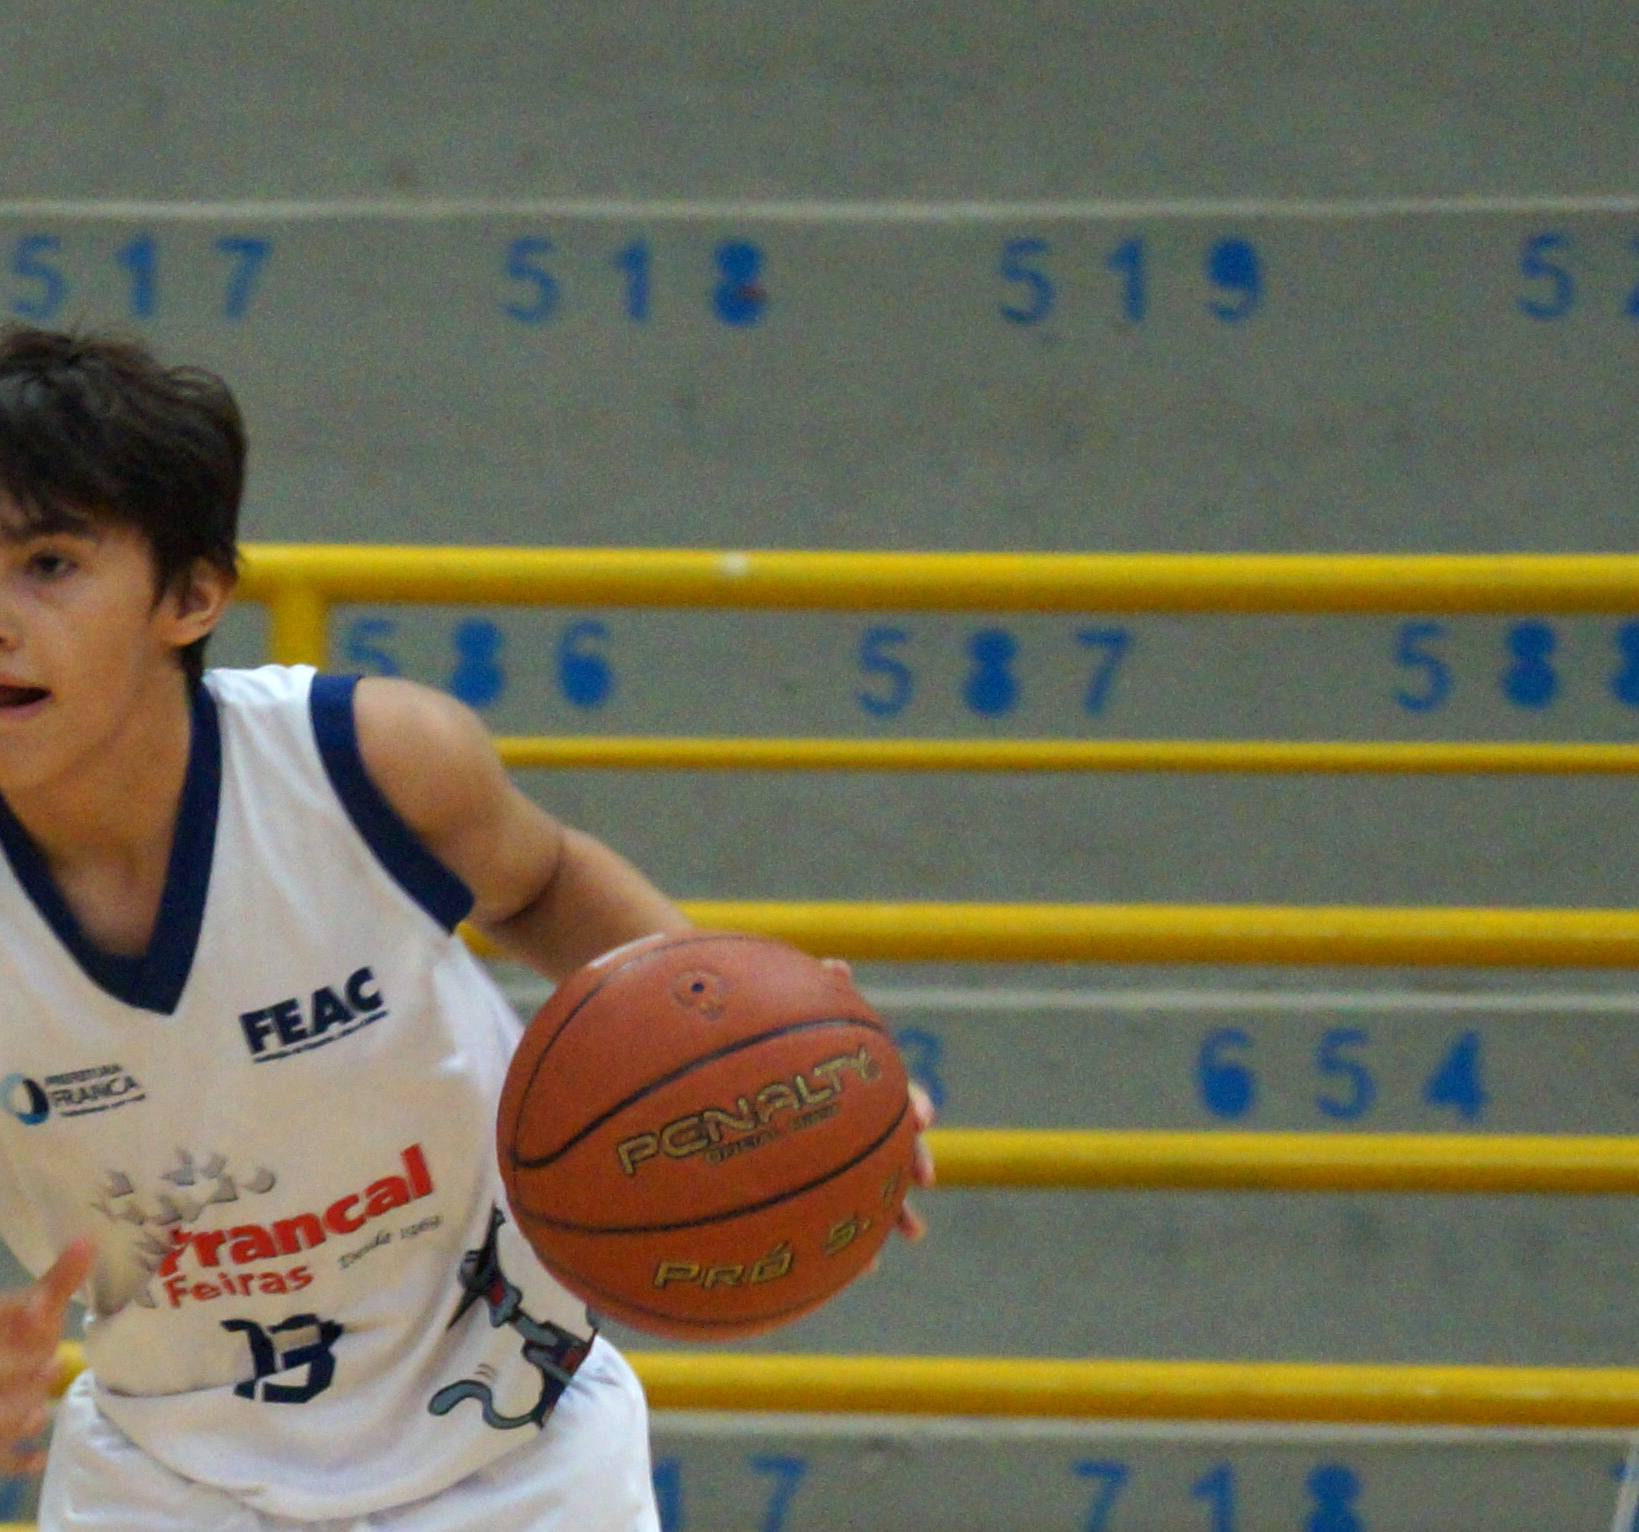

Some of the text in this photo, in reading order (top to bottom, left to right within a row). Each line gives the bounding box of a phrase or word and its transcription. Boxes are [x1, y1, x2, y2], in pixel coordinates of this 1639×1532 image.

[8, 231, 275, 323] 517
[501, 233, 772, 333] 518
[996, 231, 1269, 328] 519
[1516, 228, 1639, 324] 5
[854, 622, 1136, 724] 587
[238, 964, 386, 1055] FEAC
[48, 1075, 141, 1108] FRANCA
[616, 1042, 881, 1175] PENALTY
[1189, 1023, 1493, 1125] 654
[164, 1264, 314, 1308] Feiras
[219, 1312, 344, 1404] 13
